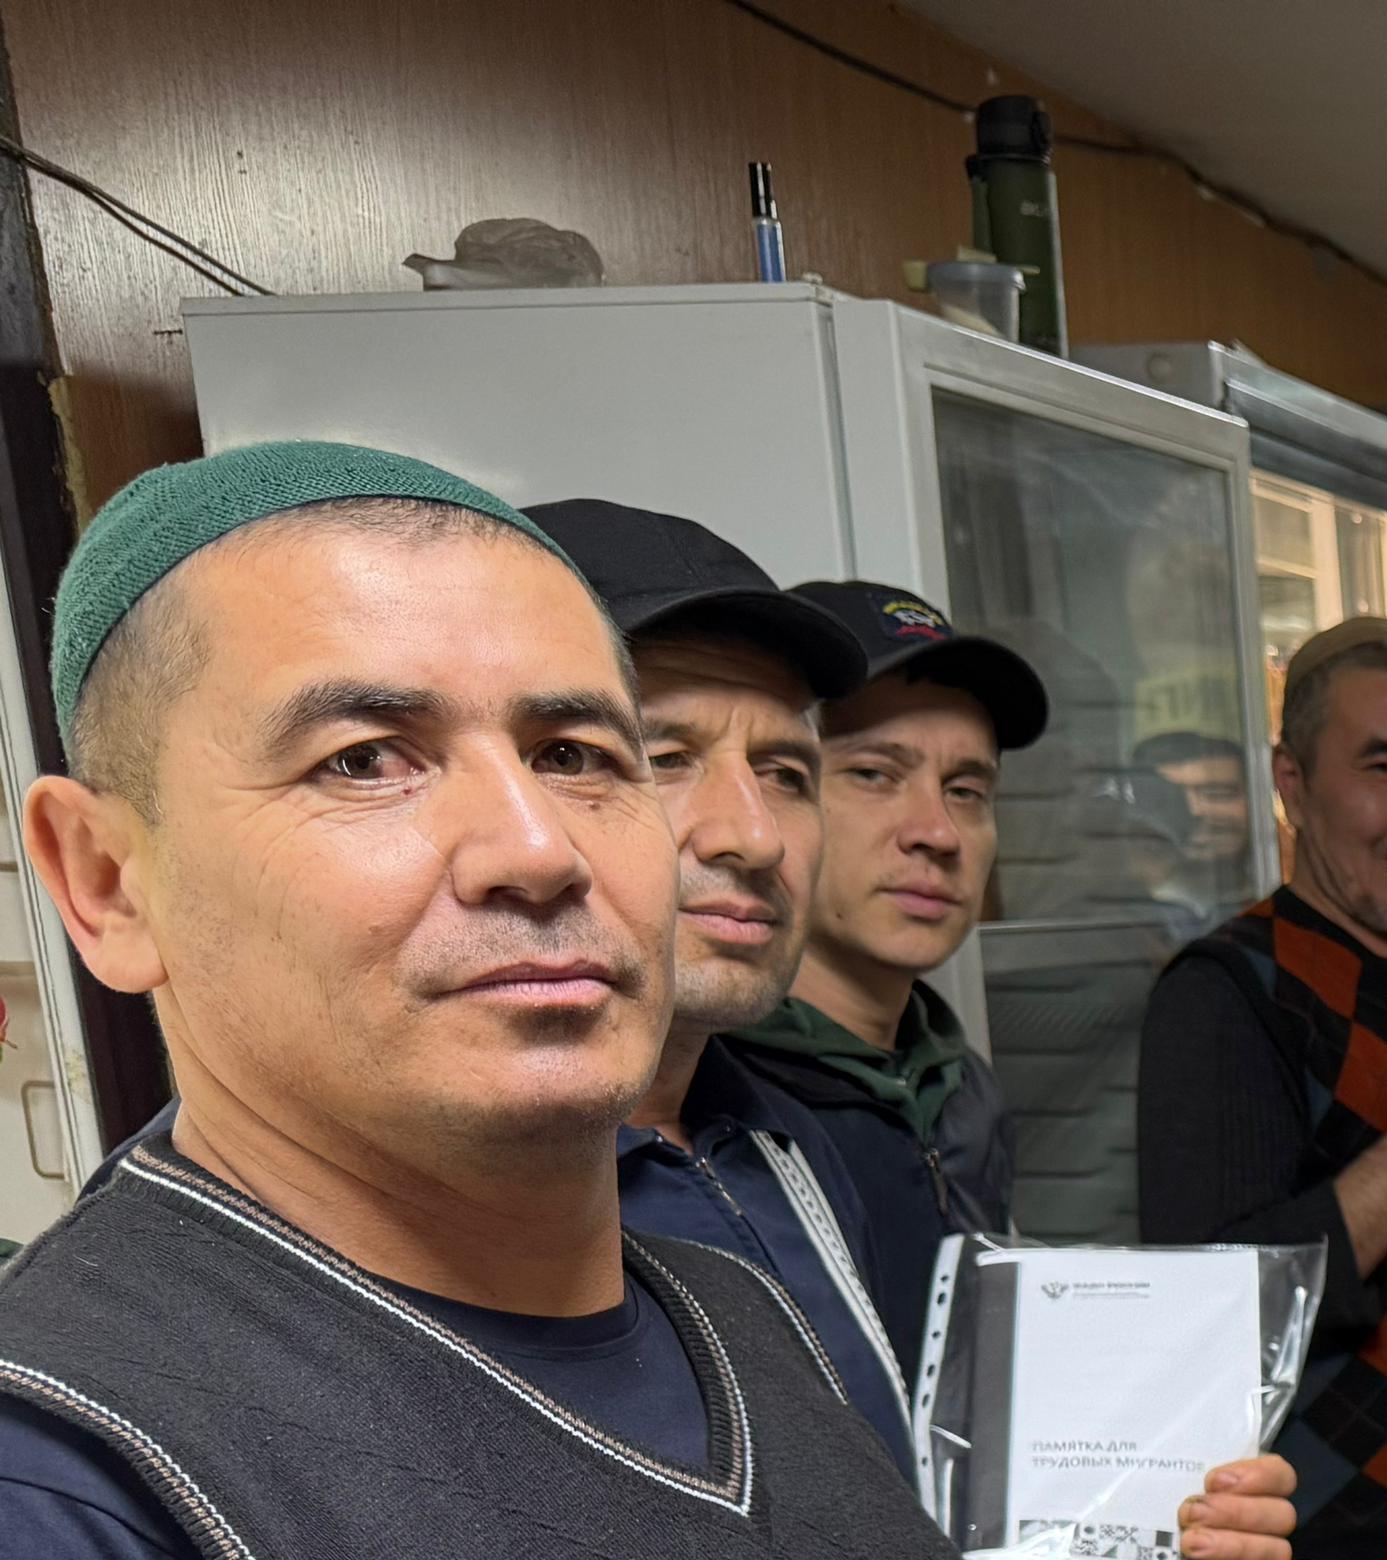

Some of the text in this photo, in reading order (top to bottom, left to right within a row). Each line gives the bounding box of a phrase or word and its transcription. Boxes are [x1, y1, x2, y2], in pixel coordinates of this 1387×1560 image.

[1032, 1439, 1137, 1453] ПАМЯТКА ДЛЯ
[1032, 1455, 1112, 1469] ТРУДОВЫХ
